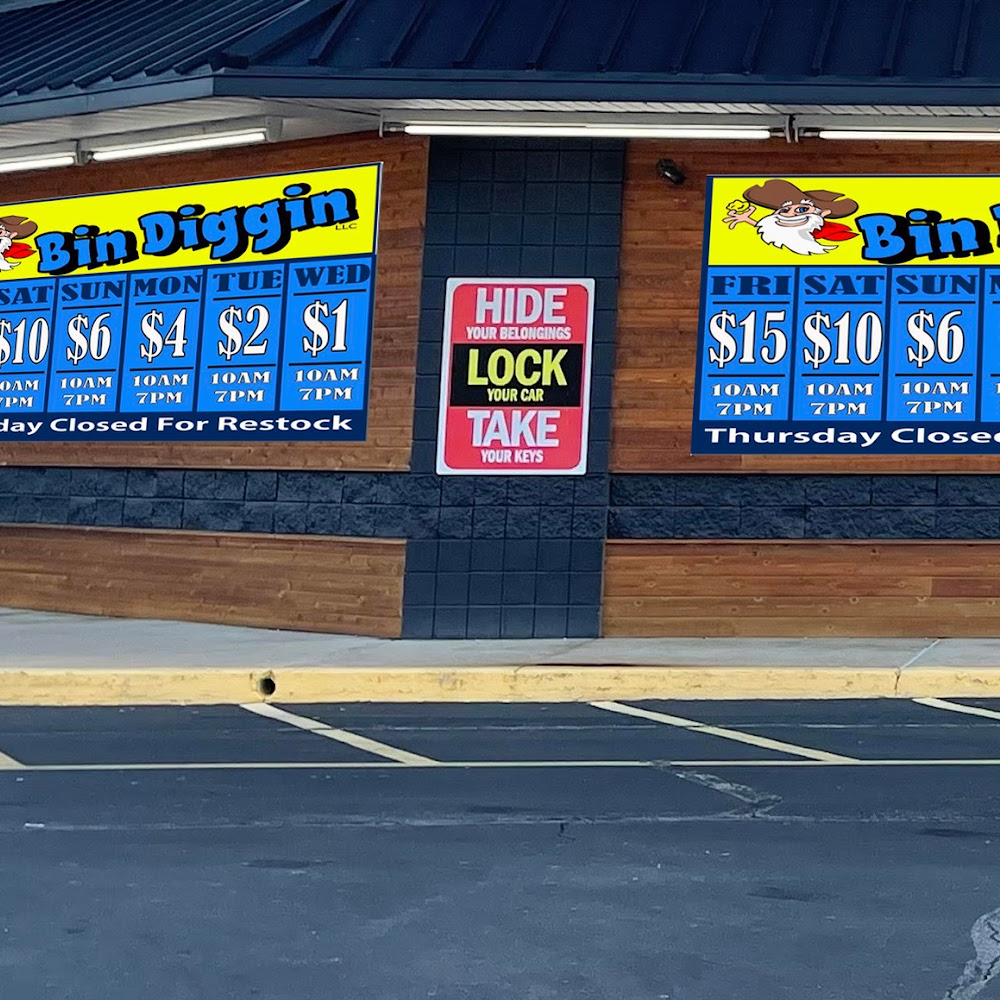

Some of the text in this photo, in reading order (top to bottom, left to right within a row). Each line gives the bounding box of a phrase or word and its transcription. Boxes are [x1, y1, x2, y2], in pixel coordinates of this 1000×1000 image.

[34, 183, 360, 275] Bin Diggin
[335, 223, 357, 231] LLC
[855, 207, 995, 265] Bin
[0, 263, 370, 305] SAT SUN MON TUE WED
[710, 275, 793, 296] FRI
[804, 274, 885, 295] SAT
[896, 274, 978, 295] SUN
[475, 287, 568, 324] HIDE
[66, 312, 112, 366] $6
[140, 307, 188, 364] $4
[217, 304, 270, 361] $2
[302, 298, 349, 358] $1
[466, 326, 572, 340] YOUR BELONGINGS
[708, 309, 788, 369] $15
[803, 309, 883, 370] $10
[906, 308, 965, 368] $6
[467, 348, 568, 386] LOCK
[60, 376, 113, 389] 10AM
[133, 373, 189, 387] 10AM
[210, 370, 272, 385] 10AM
[295, 368, 359, 382] 10AM
[710, 383, 780, 397] 10AM
[804, 382, 874, 396] 10AM
[900, 381, 970, 395] 10AM
[62, 393, 107, 406] 7PM
[135, 391, 183, 404] 7PM
[214, 389, 265, 402] 7PM
[299, 387, 353, 401] 7PM
[487, 388, 544, 402] YOUR CAR
[715, 402, 774, 416] 7PM
[809, 402, 867, 415] 7PM
[905, 401, 964, 414] 7PM
[50, 416, 148, 432] Closed
[157, 416, 209, 431] For
[218, 415, 353, 431] Restock
[467, 410, 561, 448] TAKE
[704, 427, 882, 448] Thursday
[481, 450, 544, 464] YOUR KEYS
